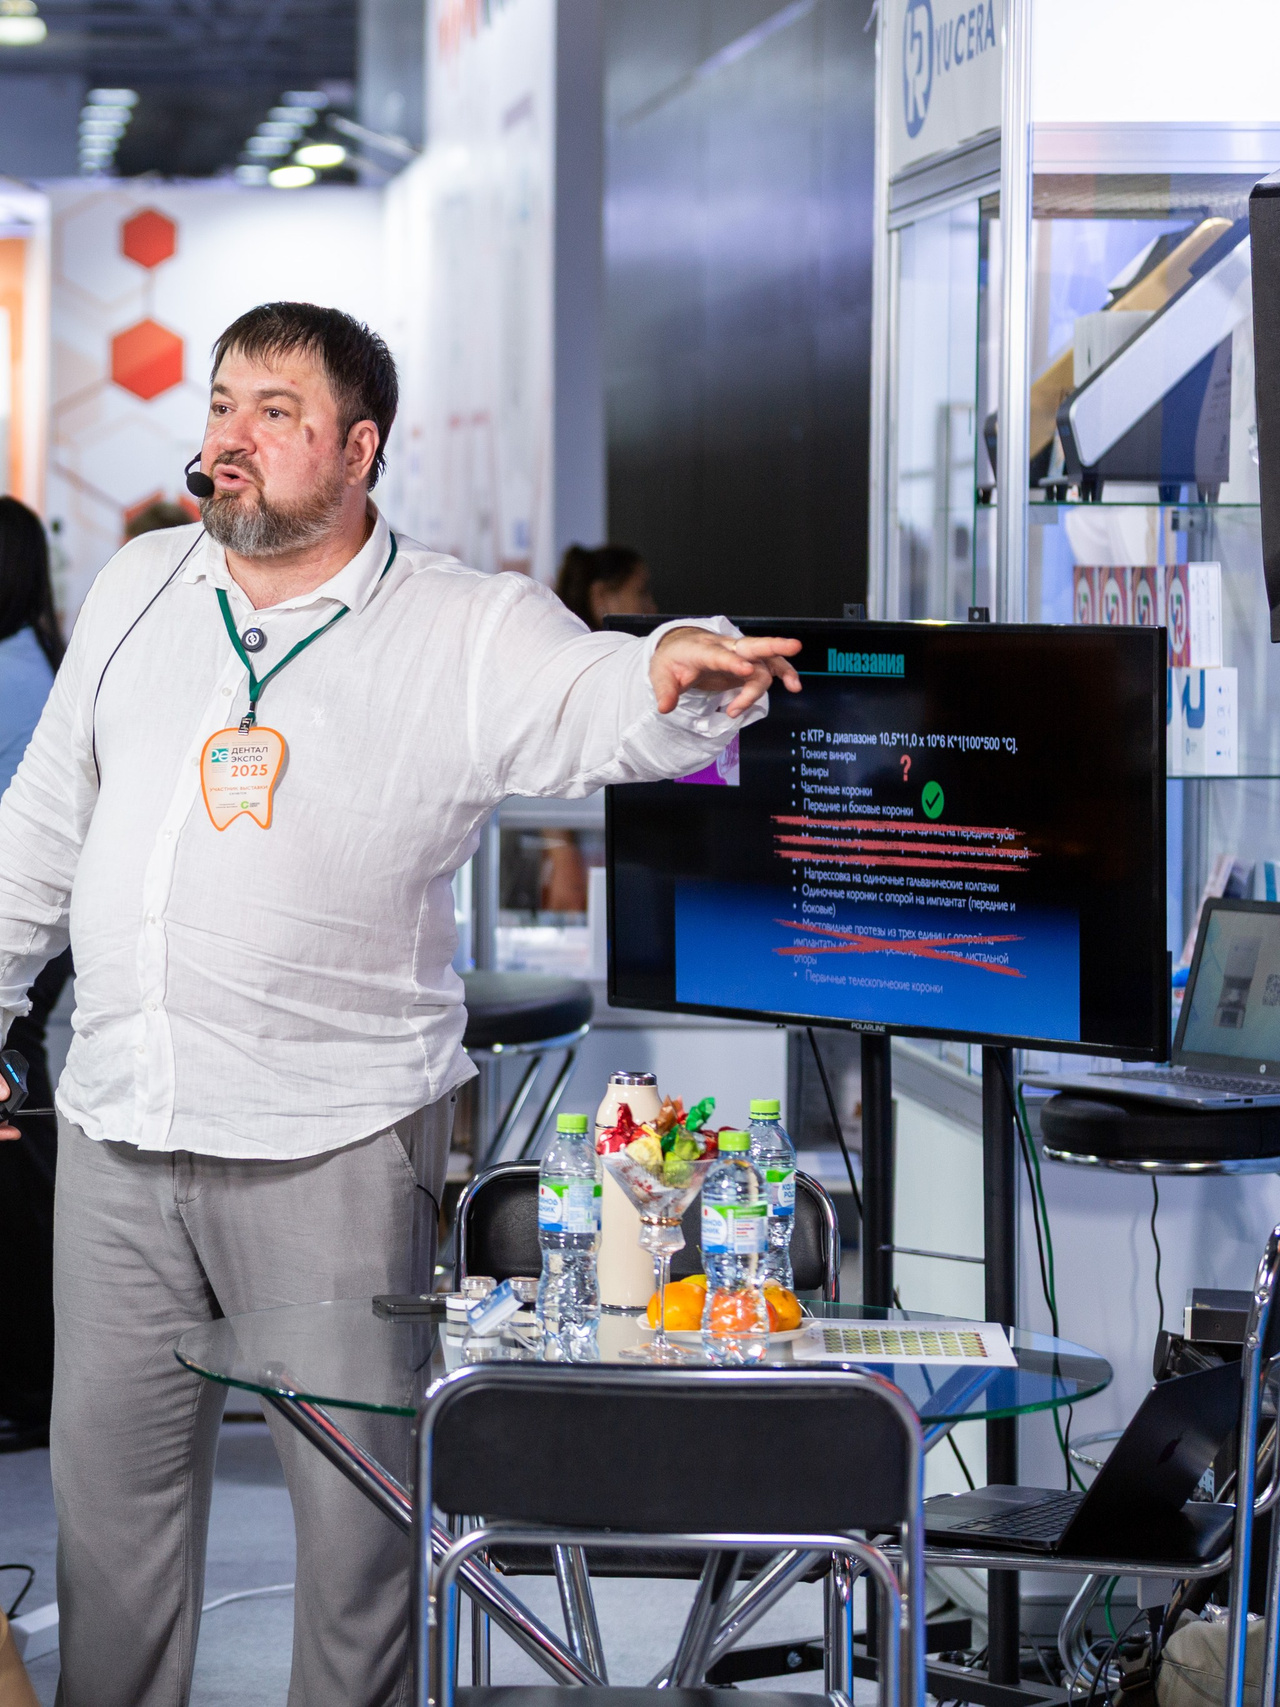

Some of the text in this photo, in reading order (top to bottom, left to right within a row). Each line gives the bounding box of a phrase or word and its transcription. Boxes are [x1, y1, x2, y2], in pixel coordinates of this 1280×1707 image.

[935, 0, 996, 76] YUCERA
[827, 647, 905, 674] Показания
[807, 728, 825, 742] КТР
[832, 732, 878, 746] диапазоне
[231, 746, 269, 755] ДЕНТАЛ
[231, 755, 263, 763] ЭКСПО
[800, 745, 857, 764] Тонкие виниры
[230, 763, 269, 777] 2025
[800, 762, 830, 780] Виниры
[800, 780, 873, 799] Частичные коронки
[803, 797, 914, 819] Передние и боковые коронки
[803, 866, 1000, 893] Напрессовка на одиночные гальванические колпачки
[801, 883, 845, 900] Одиночные
[846, 889, 877, 903] коронки
[884, 892, 914, 906] опорой
[915, 894, 925, 905] на
[926, 895, 967, 908] имплантат
[968, 895, 1009, 912] (передние
[1010, 902, 1017, 911] и
[801, 900, 837, 918] боковые)
[854, 924, 886, 938] протезы
[887, 927, 897, 937] из
[898, 928, 917, 941] трех
[793, 954, 818, 967] опоры
[805, 968, 944, 995] Первичные телескопические коронки
[851, 1022, 886, 1033] POLARLINE
